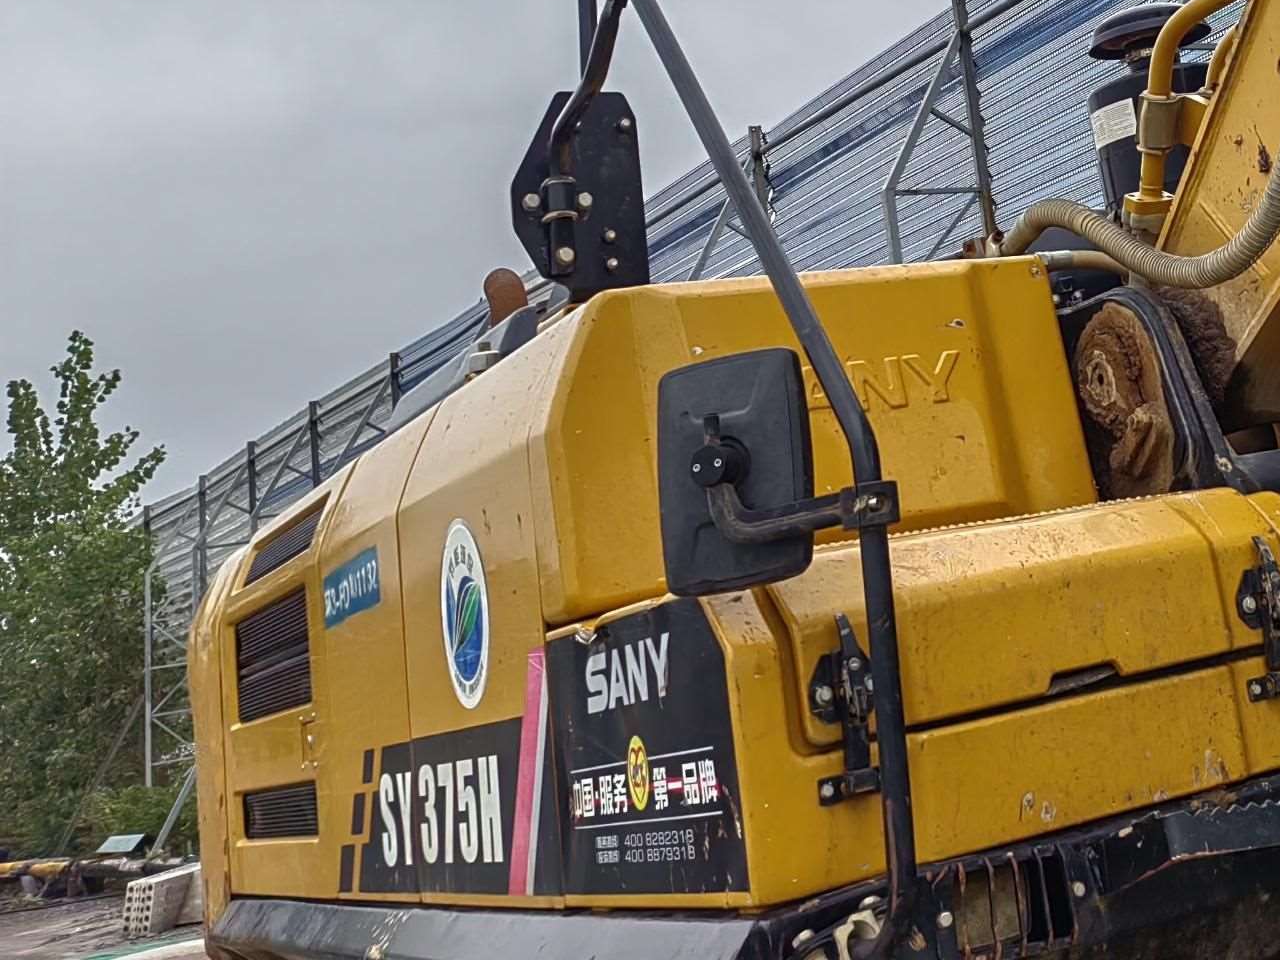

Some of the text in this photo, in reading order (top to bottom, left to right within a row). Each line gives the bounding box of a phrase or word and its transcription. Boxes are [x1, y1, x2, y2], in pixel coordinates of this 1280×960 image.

[802, 349, 961, 412] ANY
[585, 632, 670, 715] SANY
[653, 758, 719, 811] 第一品牌
